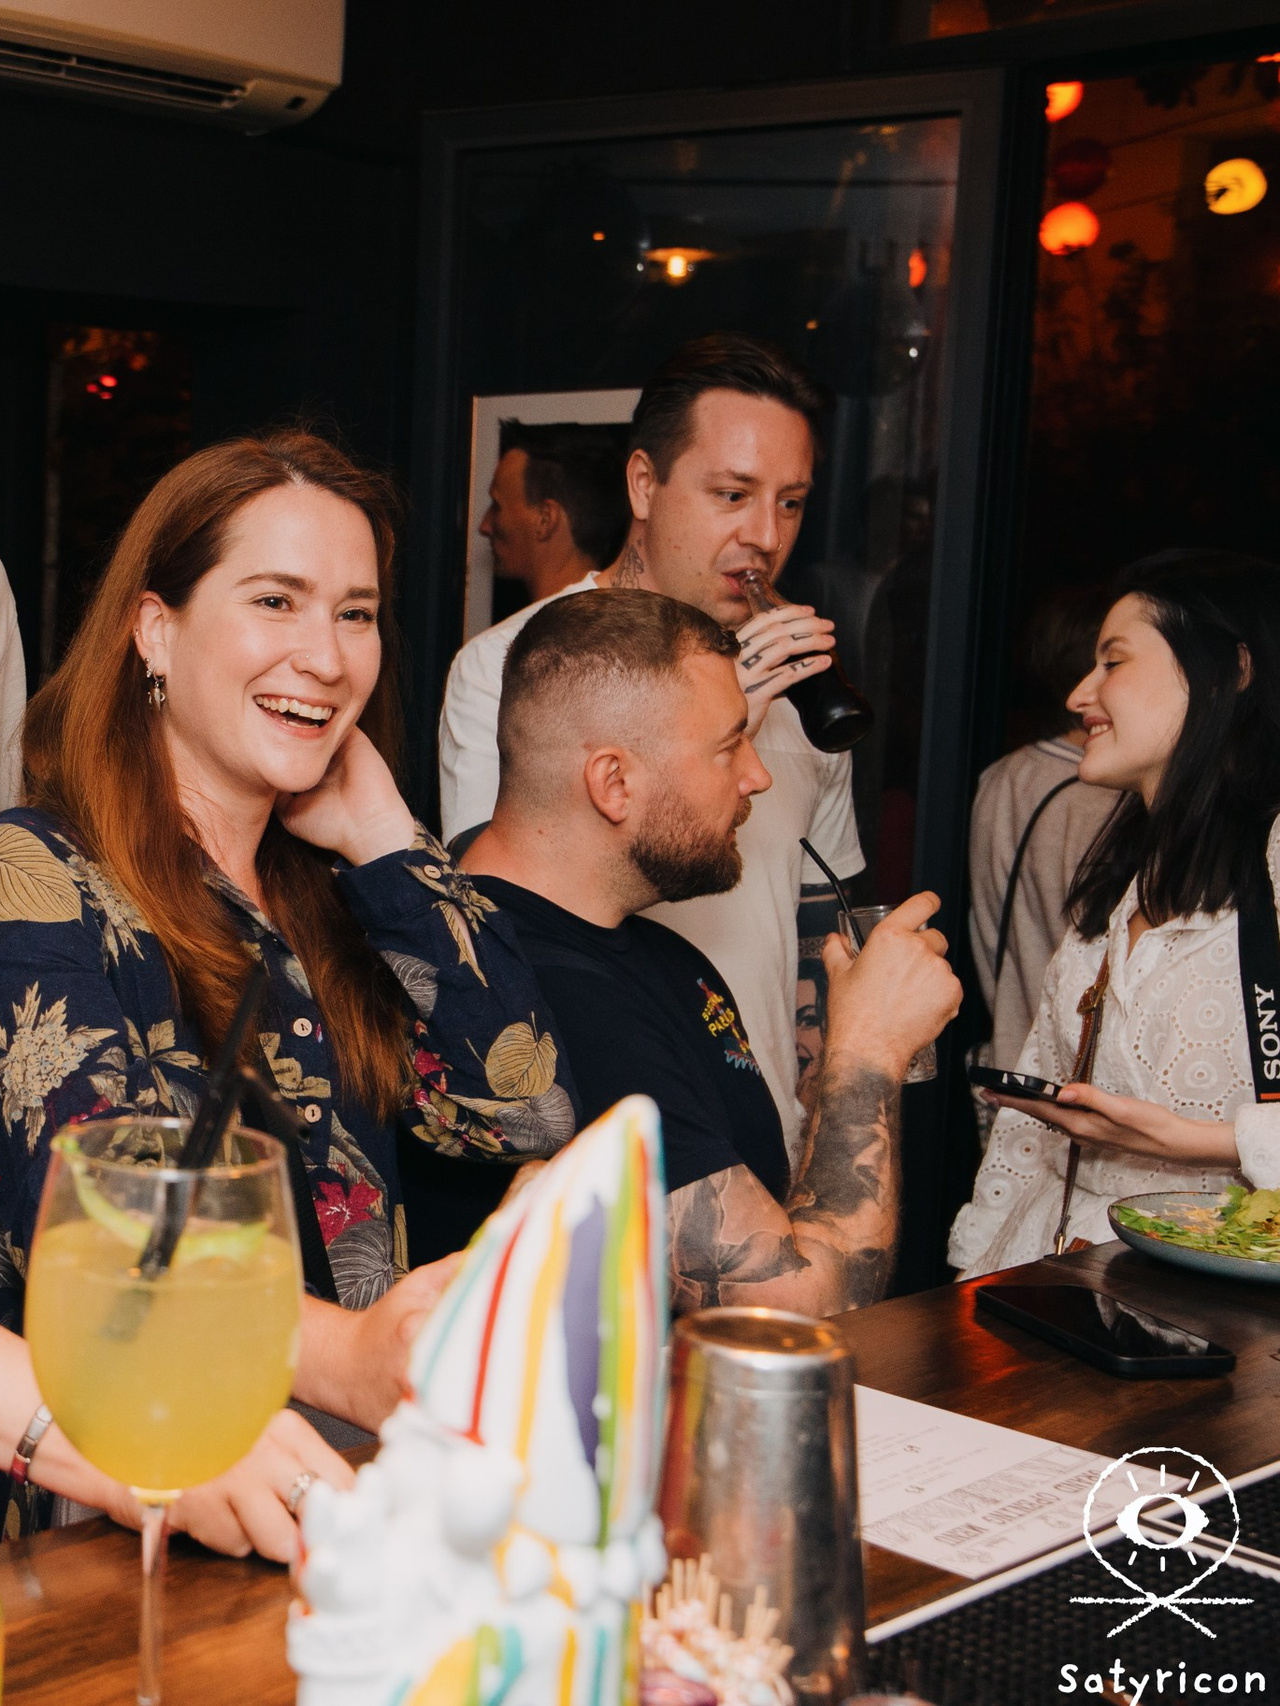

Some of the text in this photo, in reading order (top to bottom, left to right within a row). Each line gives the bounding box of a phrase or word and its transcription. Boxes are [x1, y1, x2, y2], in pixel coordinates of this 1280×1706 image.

[1254, 983, 1280, 1080] SONY
[981, 1491, 1062, 1526] OPENING
[933, 1522, 990, 1547] MENU
